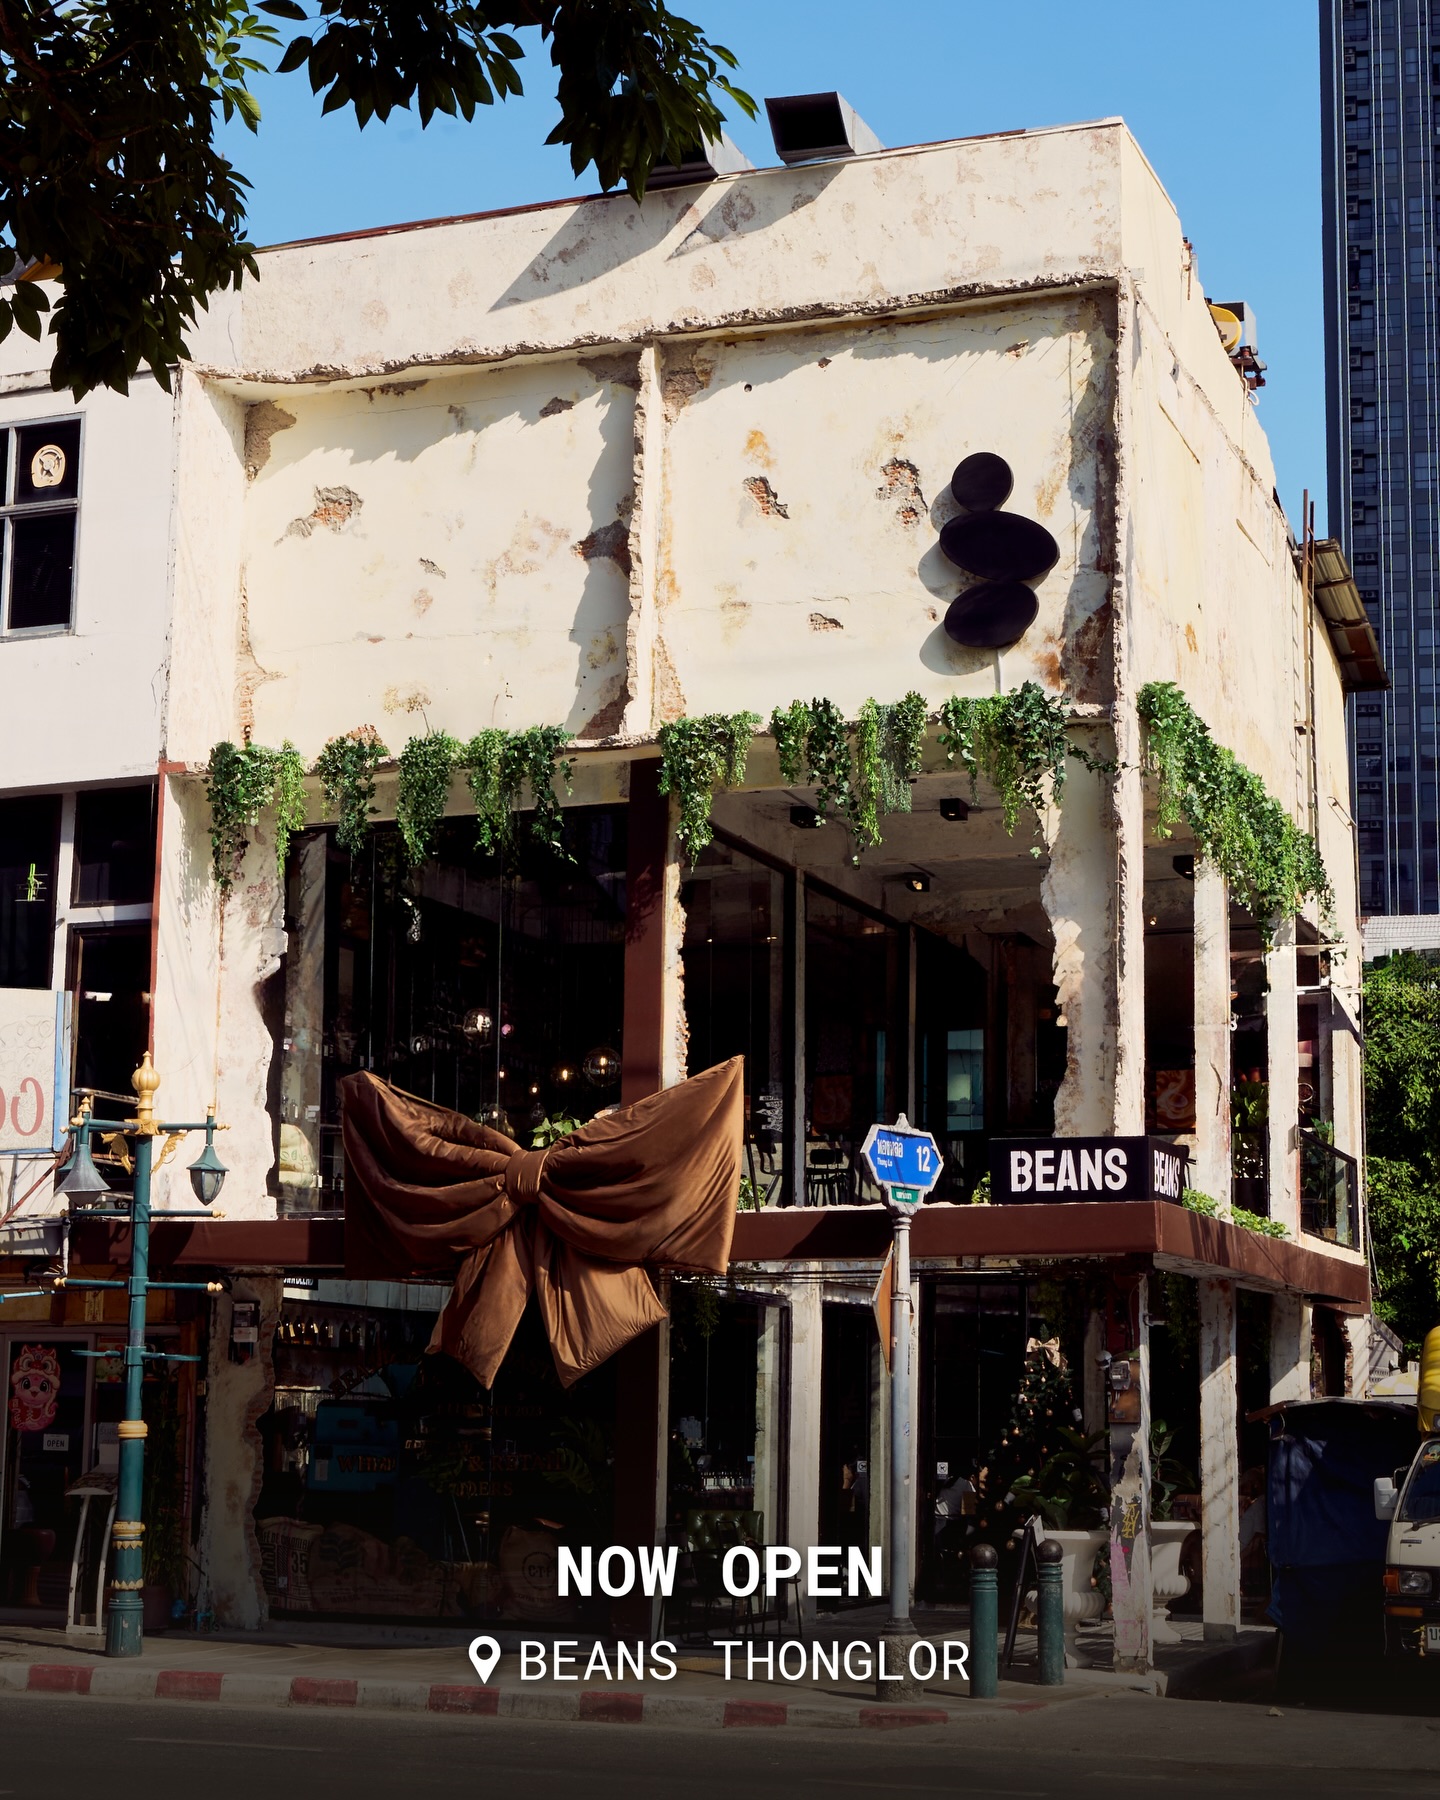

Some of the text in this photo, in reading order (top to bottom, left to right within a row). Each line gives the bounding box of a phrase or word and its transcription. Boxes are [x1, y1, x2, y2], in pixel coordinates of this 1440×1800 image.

[916, 1144, 931, 1173] 12
[1010, 1147, 1128, 1192] BEANS
[1153, 1149, 1181, 1199] BEANS
[46, 1439, 65, 1448] OPEN
[291, 1551, 309, 1575] 35
